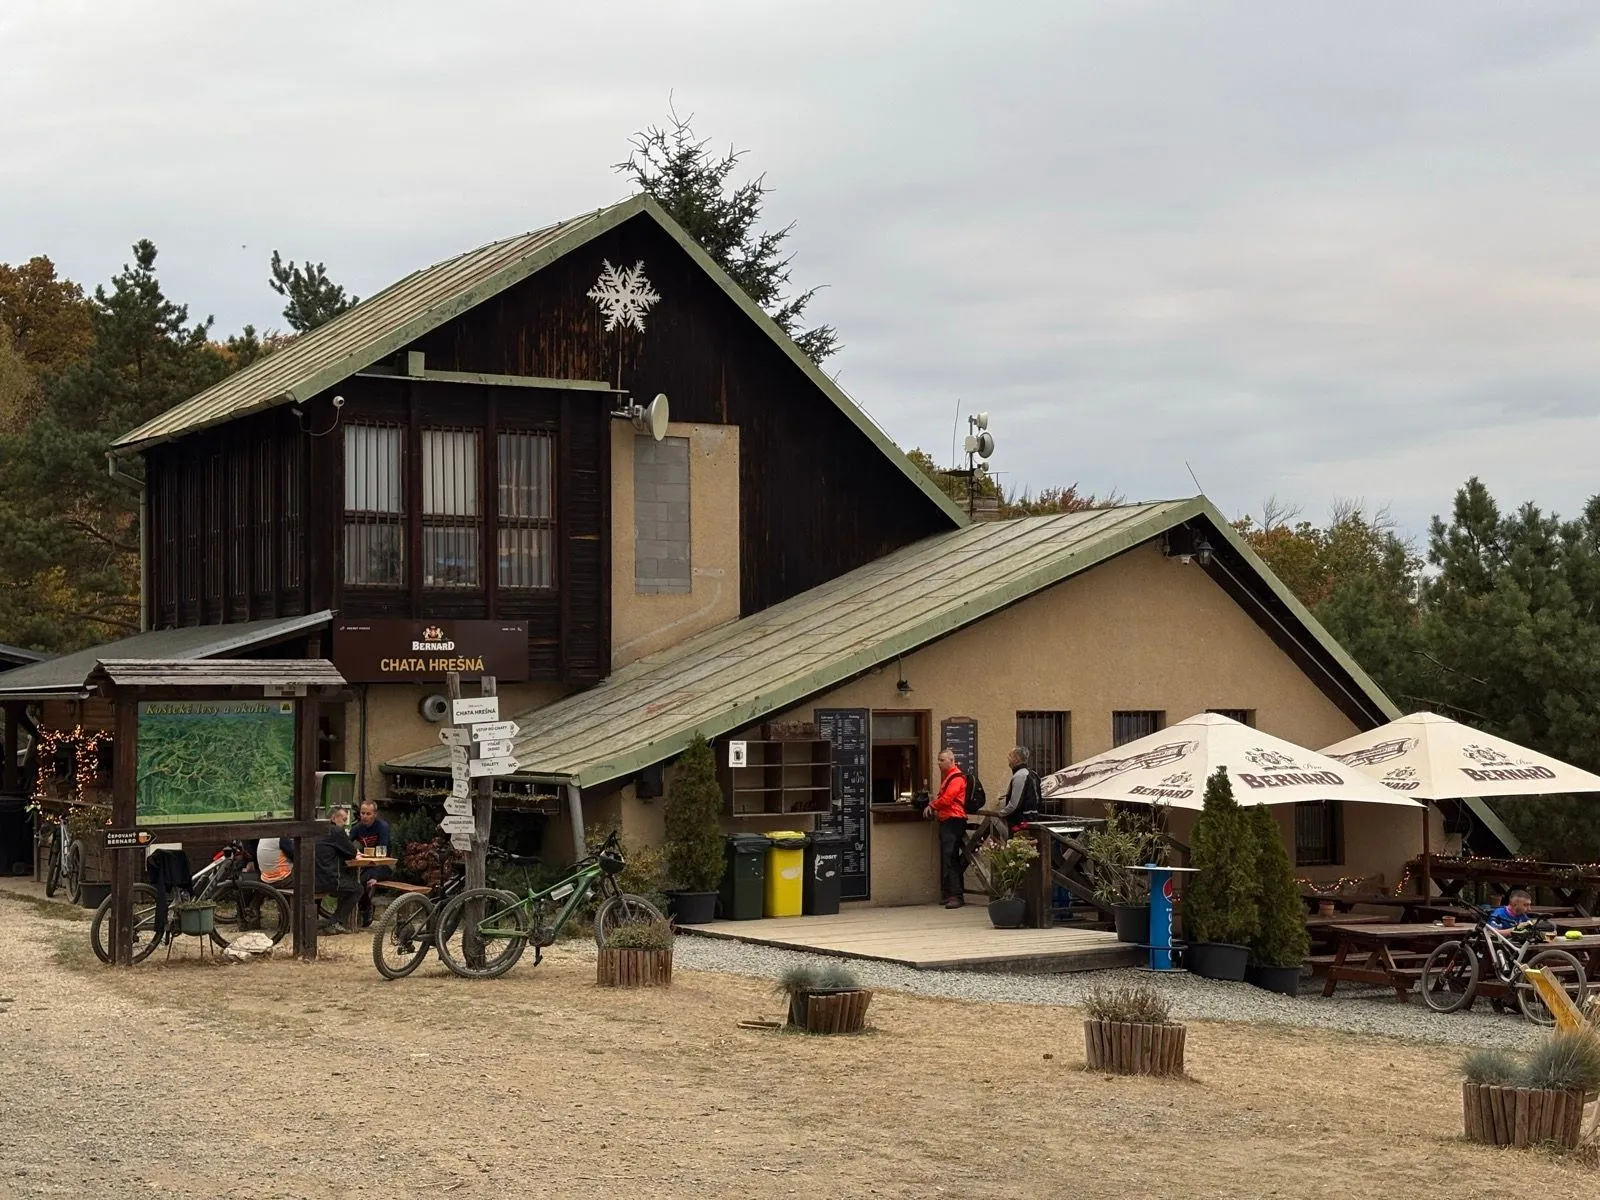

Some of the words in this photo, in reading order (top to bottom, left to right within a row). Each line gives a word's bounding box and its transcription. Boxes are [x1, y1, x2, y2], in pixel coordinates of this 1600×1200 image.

[412, 641, 455, 651] BERNARD
[380, 658, 426, 672] CHATA
[429, 655, 485, 671] HREŠNÁ
[196, 703, 219, 716] lesy
[234, 703, 270, 713] okolie
[1237, 771, 1345, 789] BERNARD
[1458, 766, 1557, 781] BERNARD
[1128, 785, 1194, 799] BERNARD
[107, 831, 137, 839] ČEPOVANÝ
